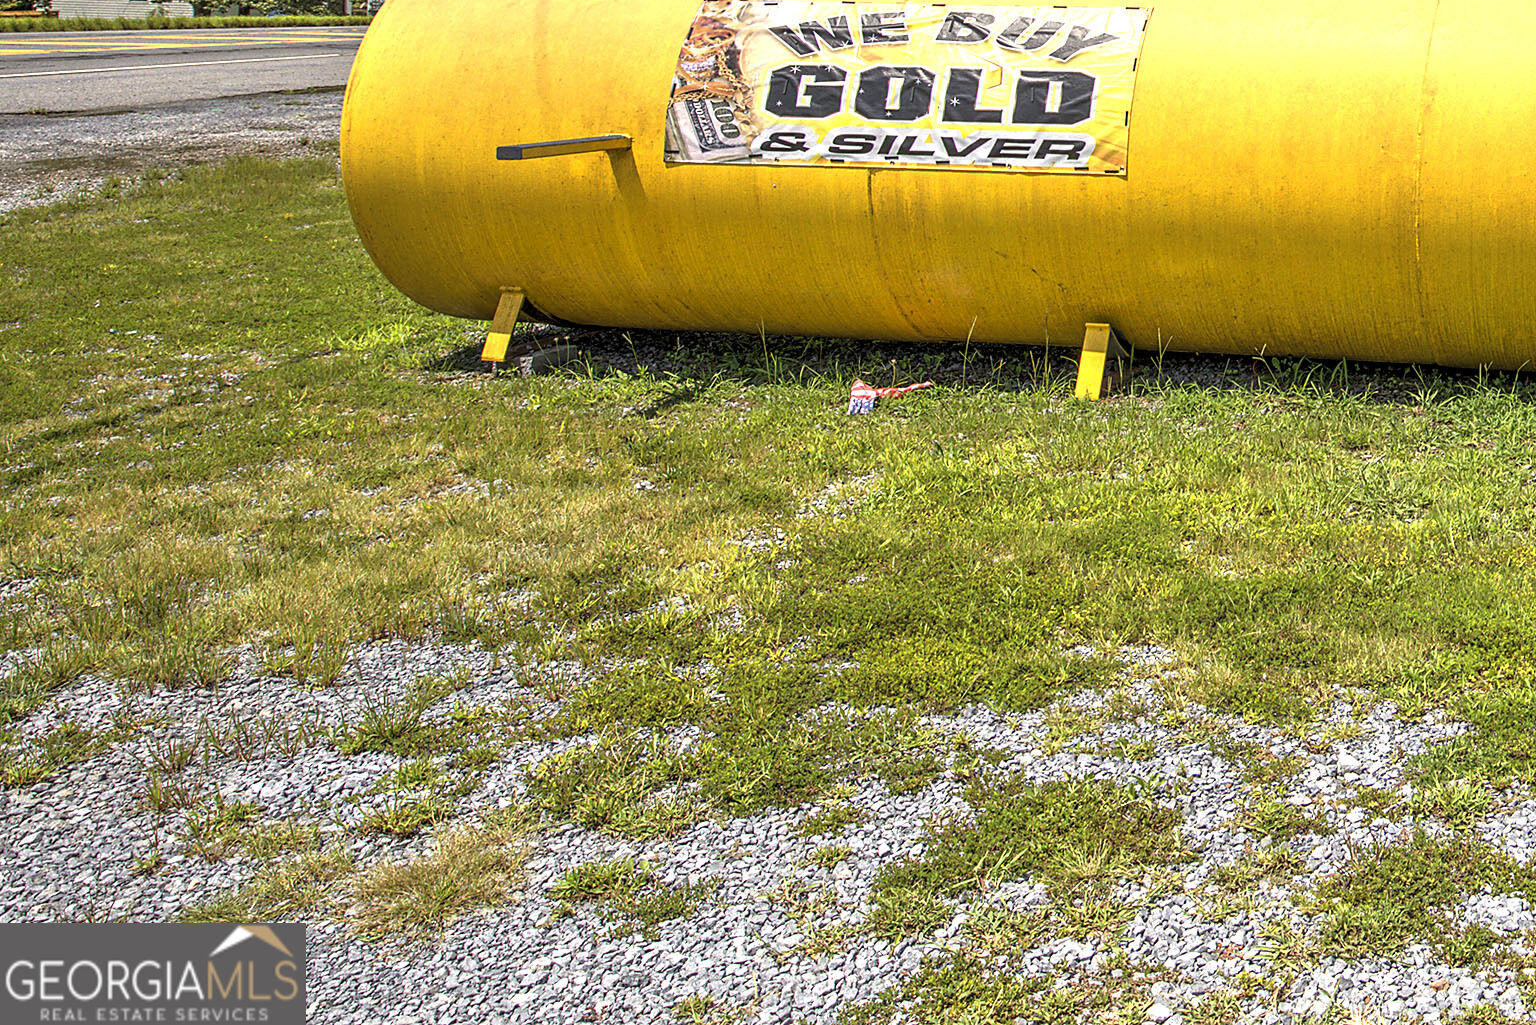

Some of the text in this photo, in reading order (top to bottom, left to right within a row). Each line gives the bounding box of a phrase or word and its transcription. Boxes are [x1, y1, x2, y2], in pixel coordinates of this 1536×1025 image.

[767, 11, 1121, 63] WE BUY
[764, 63, 1098, 126] GOLD
[760, 131, 1087, 160] & SILVER
